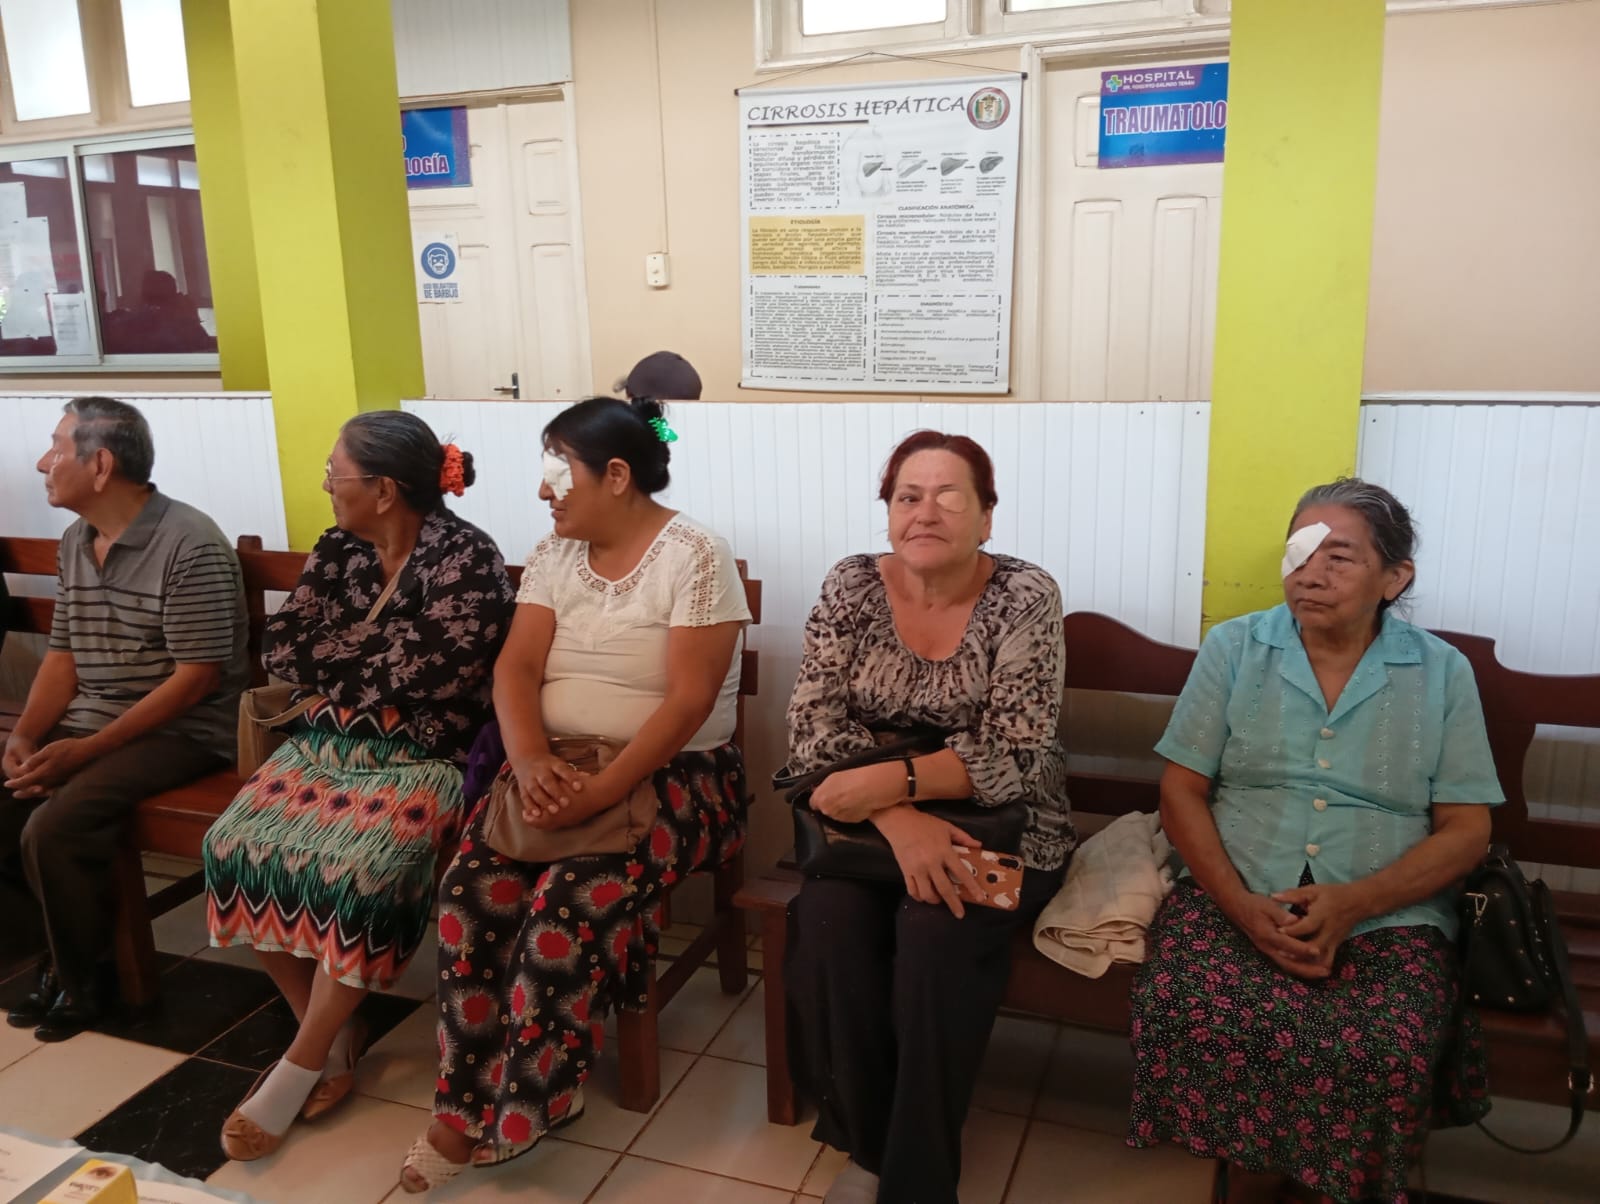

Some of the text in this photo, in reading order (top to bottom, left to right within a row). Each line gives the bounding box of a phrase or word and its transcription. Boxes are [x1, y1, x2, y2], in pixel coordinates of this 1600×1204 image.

[1123, 70, 1194, 83] HOSPITAL
[748, 96, 966, 121] CIRROSIS HEPÁTICA
[424, 289, 458, 298] DE BARBIJO
